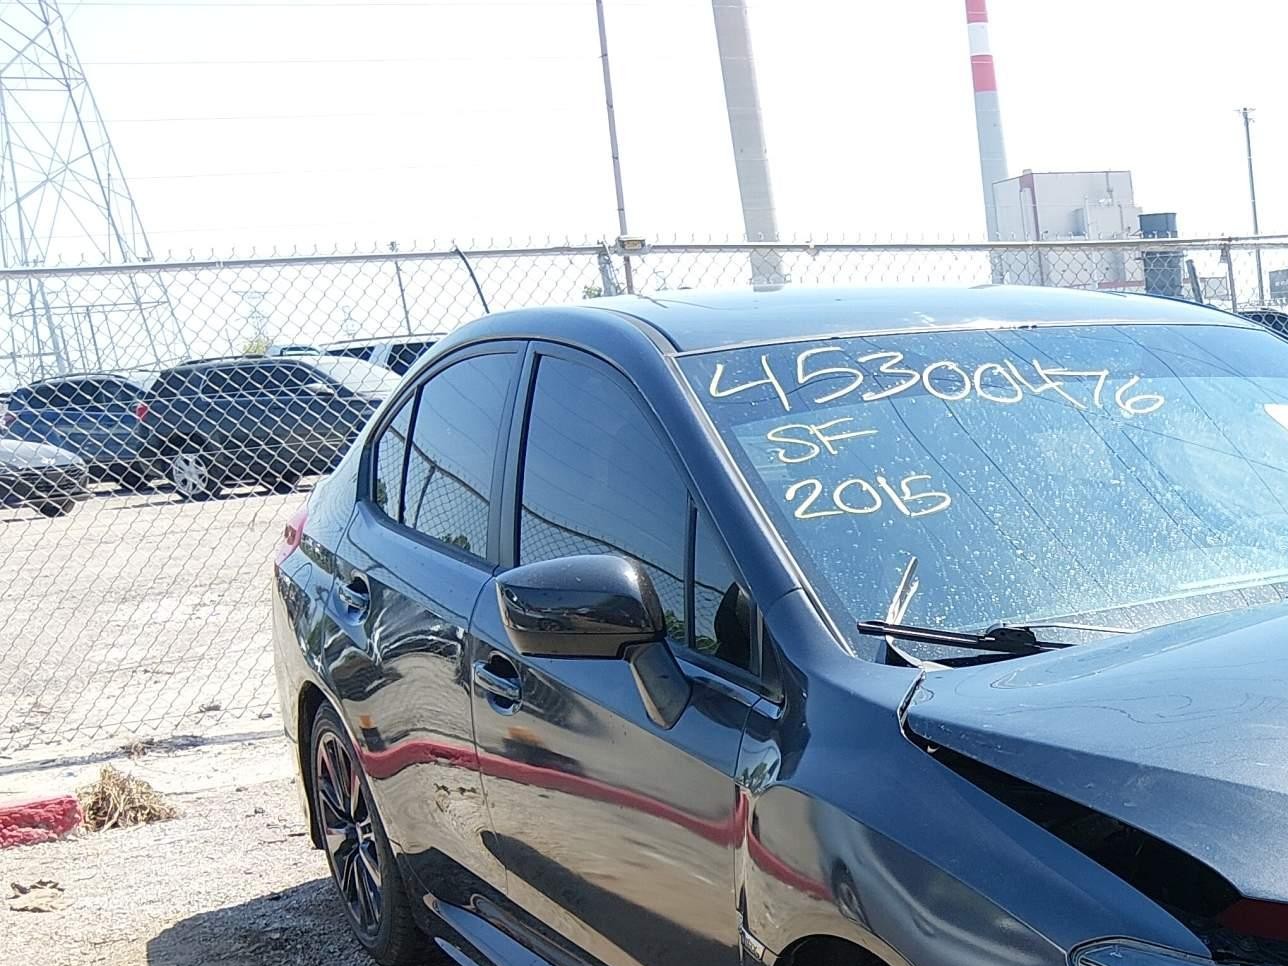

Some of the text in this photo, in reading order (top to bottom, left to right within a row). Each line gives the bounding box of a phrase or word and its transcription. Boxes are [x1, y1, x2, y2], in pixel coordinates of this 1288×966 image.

[708, 346, 1166, 414] 45300476
[766, 416, 878, 465] SF
[785, 474, 952, 519] 2015
